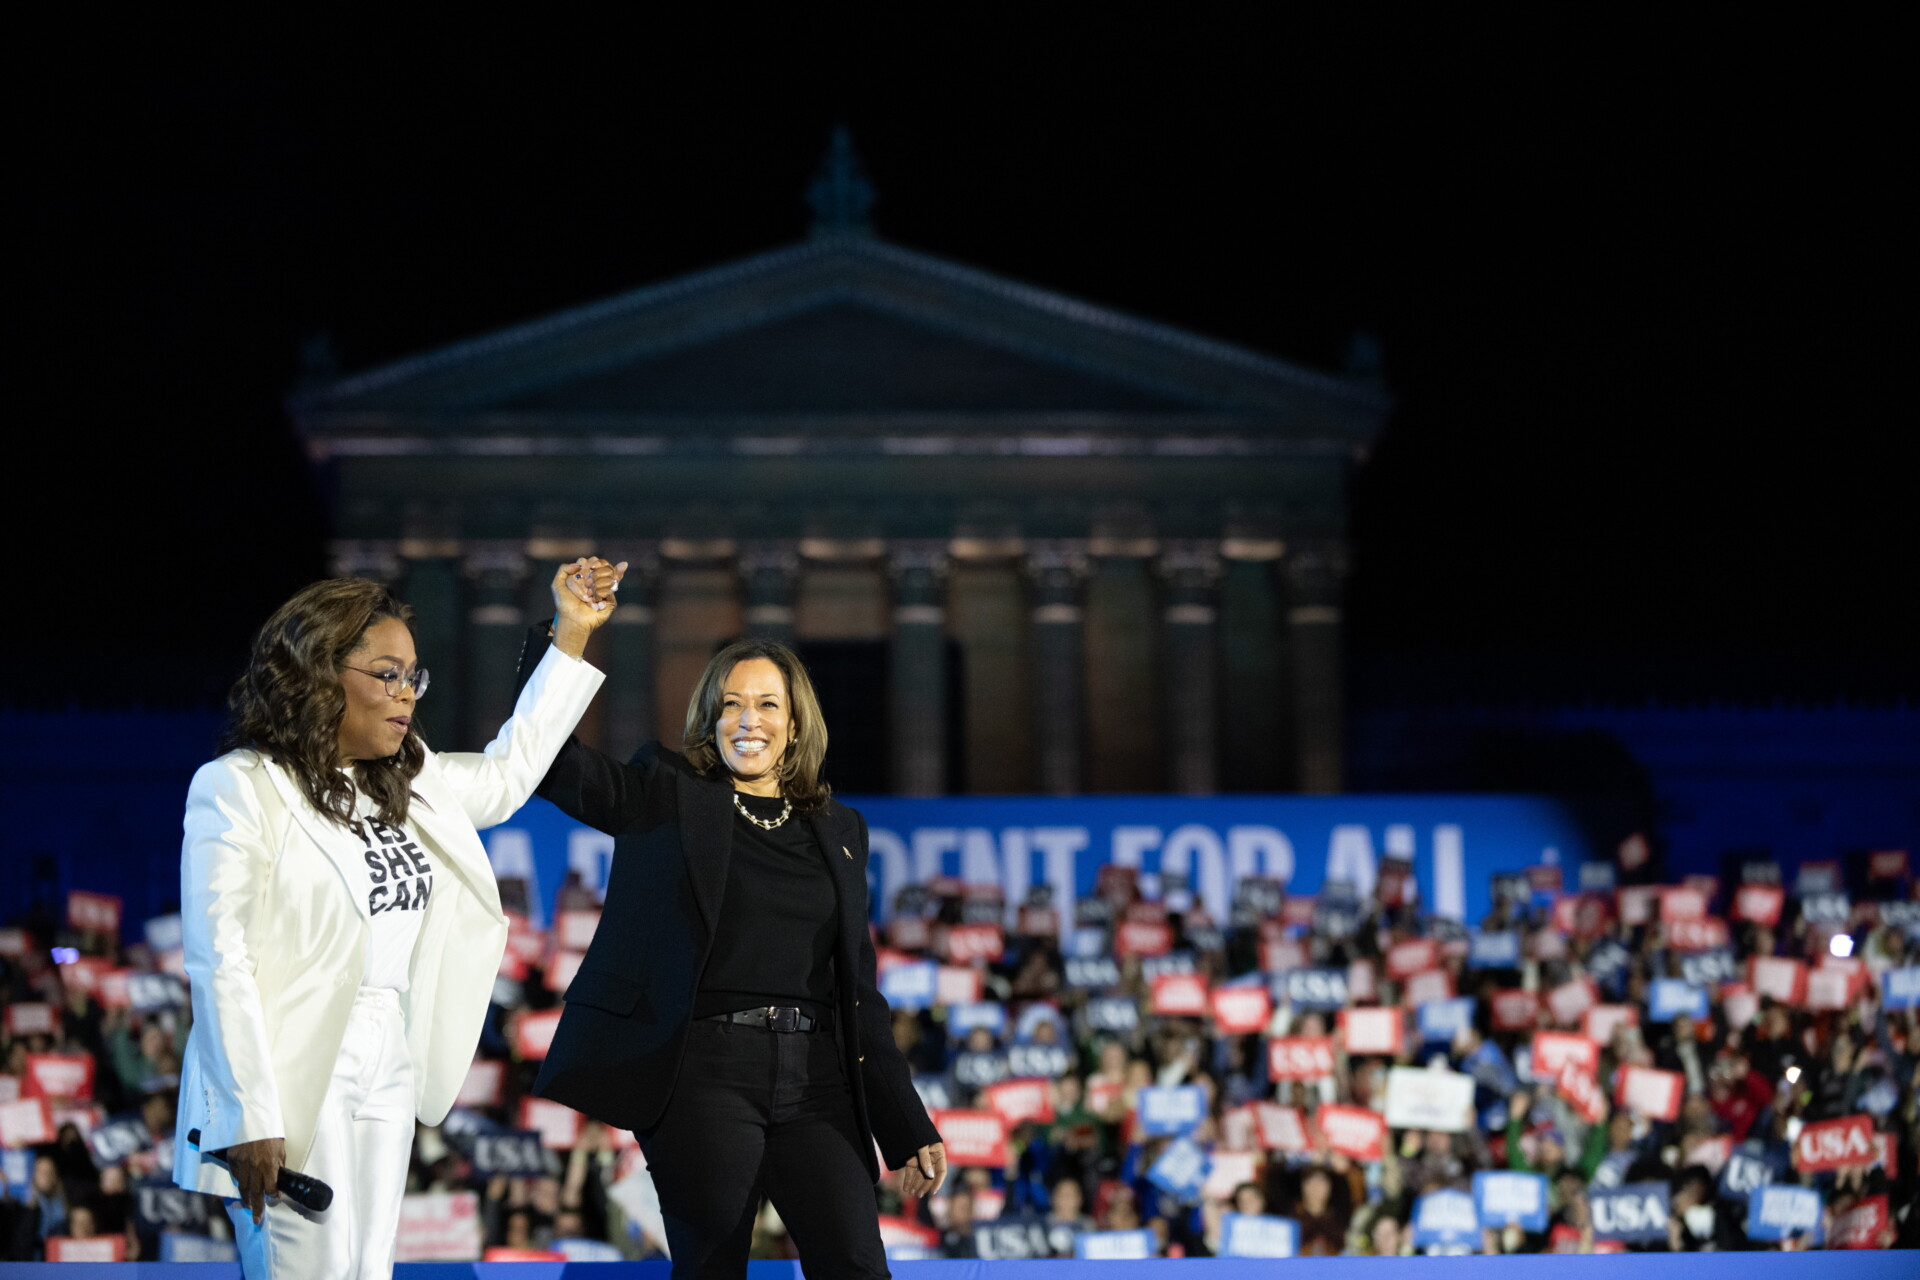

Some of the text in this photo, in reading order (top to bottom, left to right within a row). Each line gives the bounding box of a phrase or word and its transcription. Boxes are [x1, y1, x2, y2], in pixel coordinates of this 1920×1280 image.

[364, 842, 431, 884] SHE
[368, 875, 433, 917] CAN
[1288, 969, 1346, 1002] USA
[1270, 1043, 1333, 1076] USA
[474, 1135, 544, 1171] USA
[1801, 1125, 1868, 1163] USA
[139, 1186, 207, 1223] USA
[1591, 1194, 1668, 1233] USA
[975, 1222, 1049, 1260] USA
